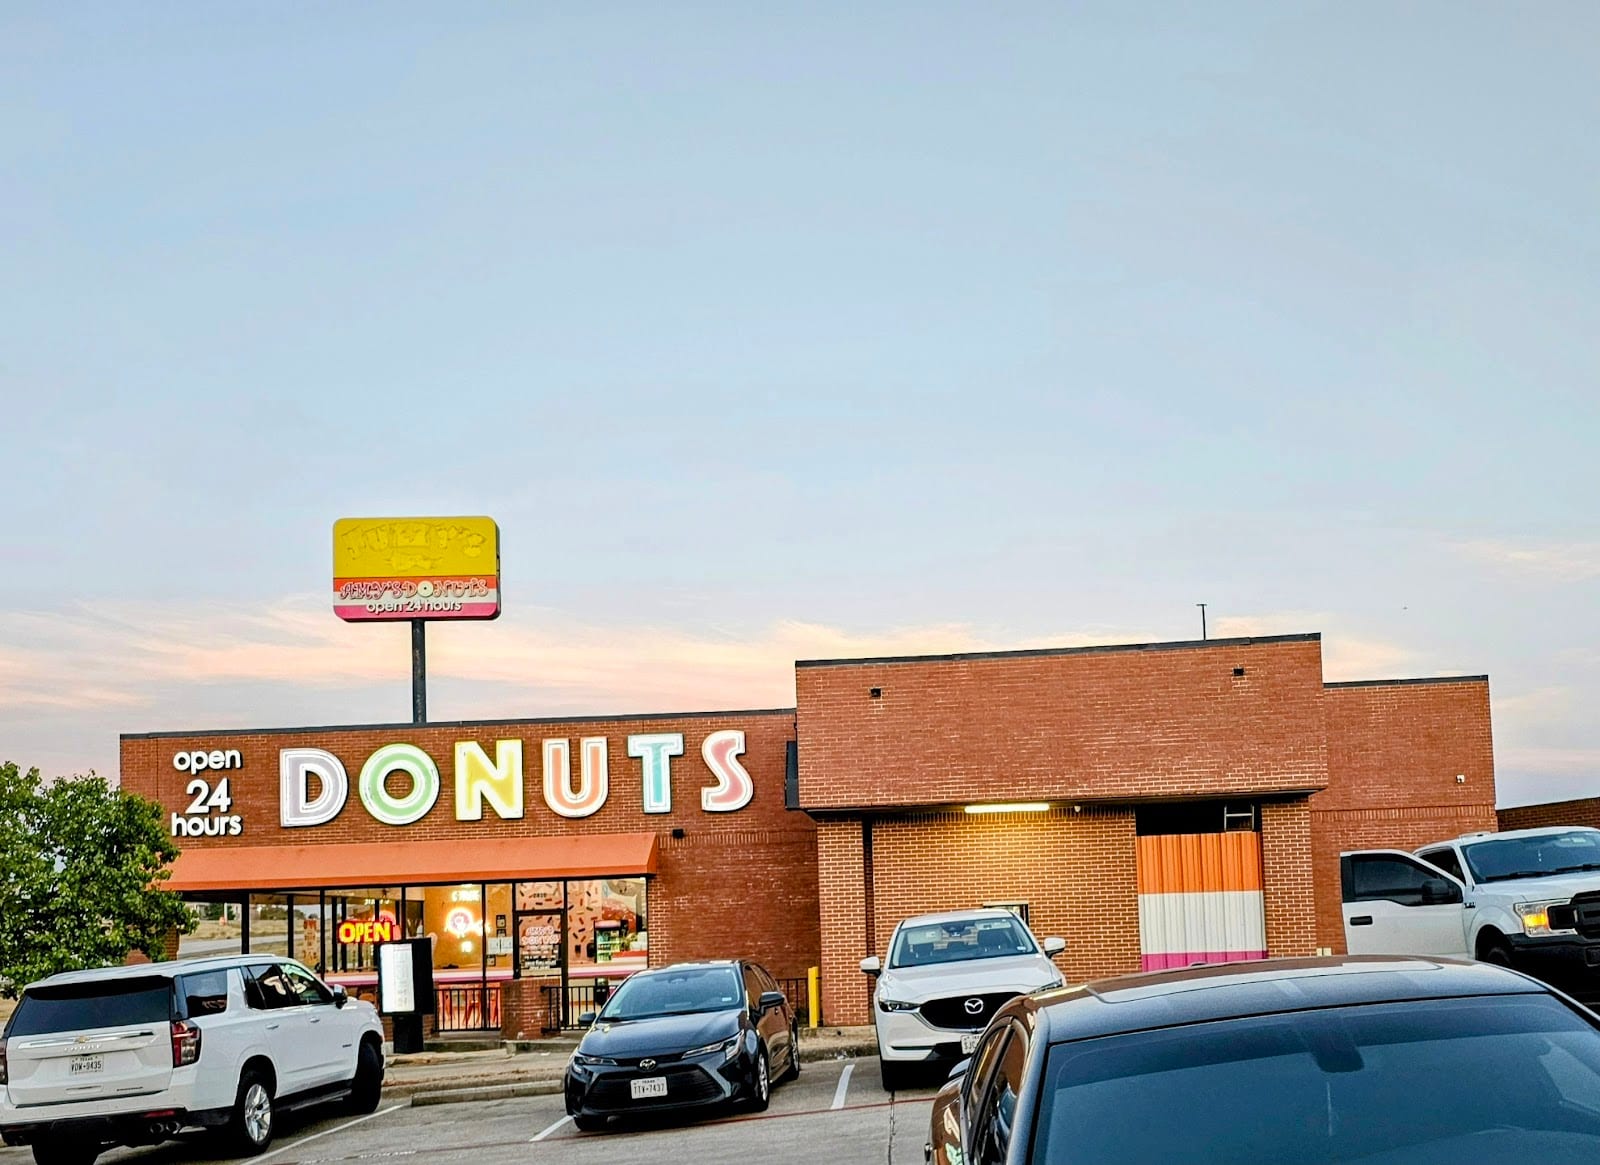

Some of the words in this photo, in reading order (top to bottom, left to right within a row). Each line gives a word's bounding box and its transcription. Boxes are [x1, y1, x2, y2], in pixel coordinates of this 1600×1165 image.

[340, 581, 403, 600] AMY'S
[402, 578, 489, 598] DONUTS
[366, 602, 402, 615] open
[406, 601, 424, 613] 24
[424, 599, 462, 612] hours
[172, 748, 242, 775] open
[279, 729, 755, 828] DONUTS
[185, 777, 232, 814] 24
[171, 812, 243, 837] hours
[338, 921, 392, 943] OPEN
